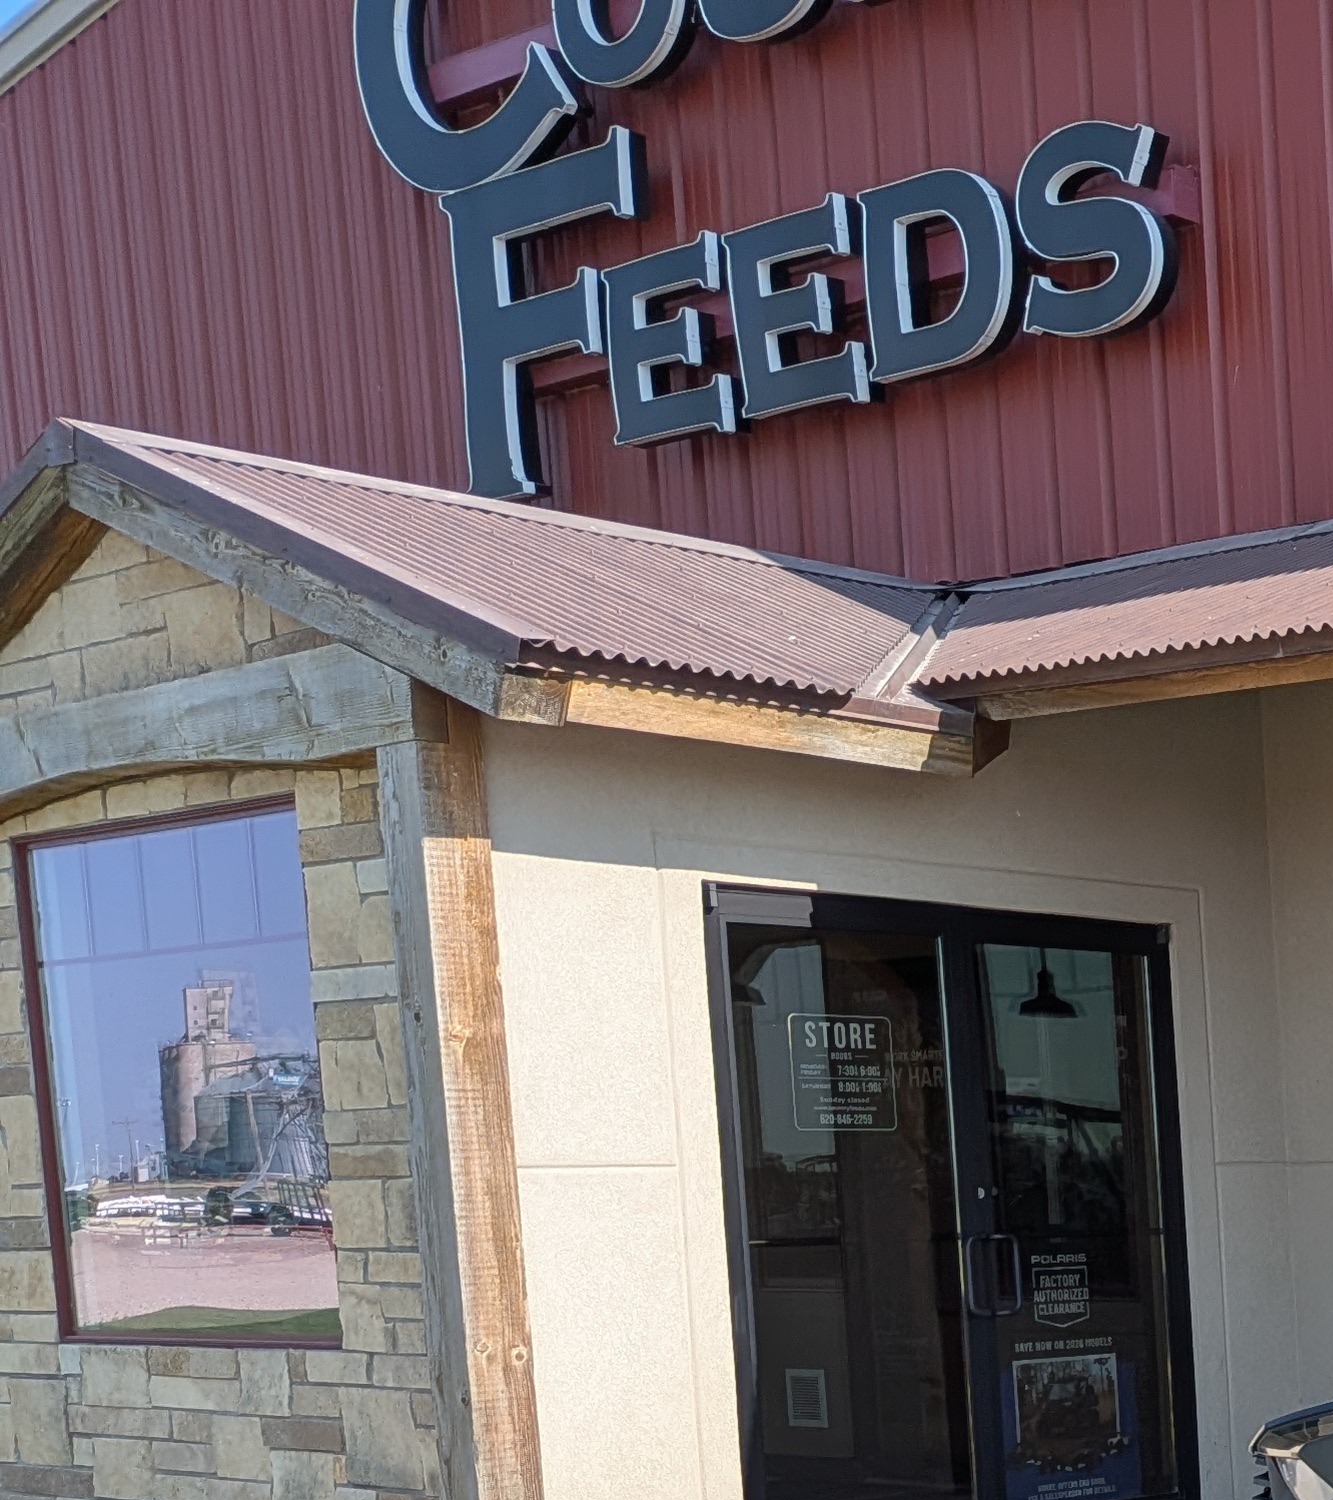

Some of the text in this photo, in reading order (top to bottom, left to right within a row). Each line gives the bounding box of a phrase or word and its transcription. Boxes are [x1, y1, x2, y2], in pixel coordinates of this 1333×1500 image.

[439, 120, 1174, 497] FEEDS
[804, 1020, 876, 1049] STORE
[1031, 1253, 1087, 1264] POLARIS
[1040, 1274, 1081, 1288] FACTORY
[1033, 1287, 1090, 1302] AUTHORIZED
[1038, 1302, 1086, 1315] CLEARANCE
[1014, 1342, 1034, 1353] SAVE
[1035, 1341, 1052, 1351] NOW
